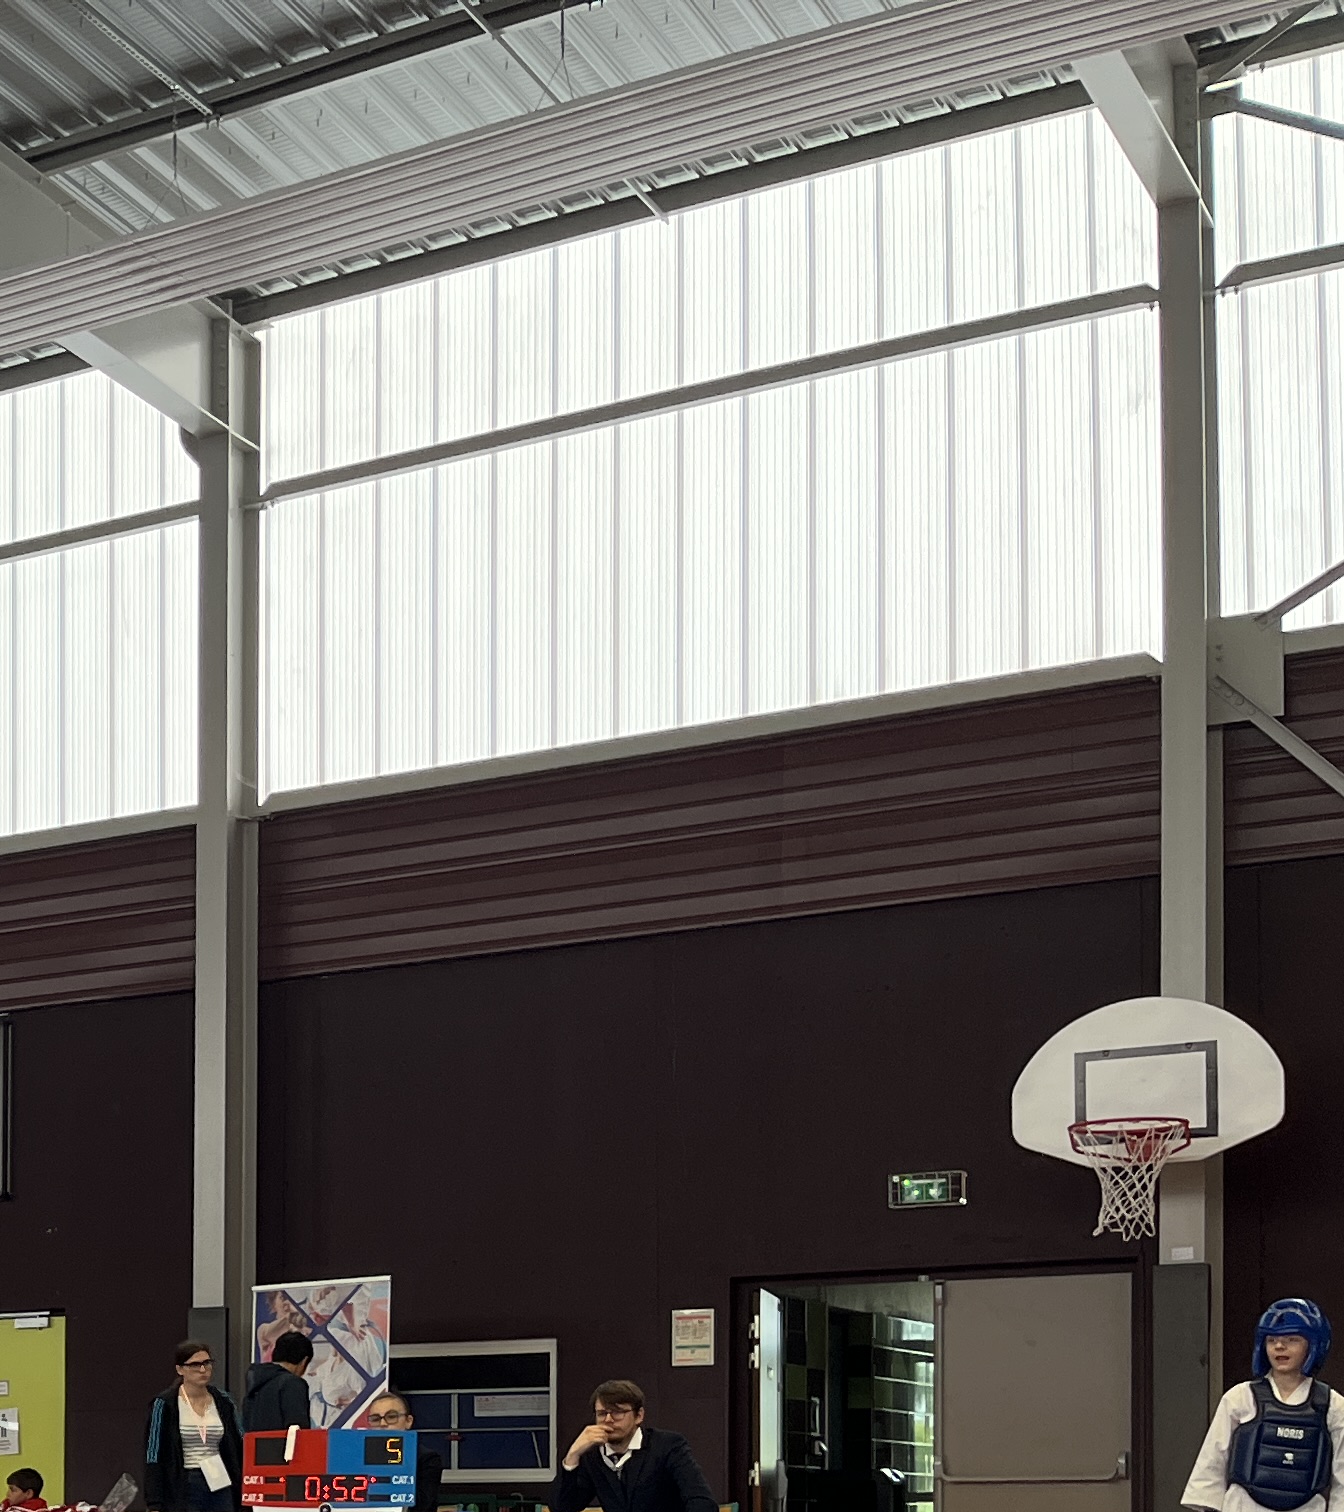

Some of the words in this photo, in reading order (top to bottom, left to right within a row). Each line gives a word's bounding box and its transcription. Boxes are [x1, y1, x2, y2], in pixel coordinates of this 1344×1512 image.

[1277, 1426, 1304, 1440] NORIS
[385, 1438, 402, 1464] 5
[305, 1476, 368, 1502] 0:52
